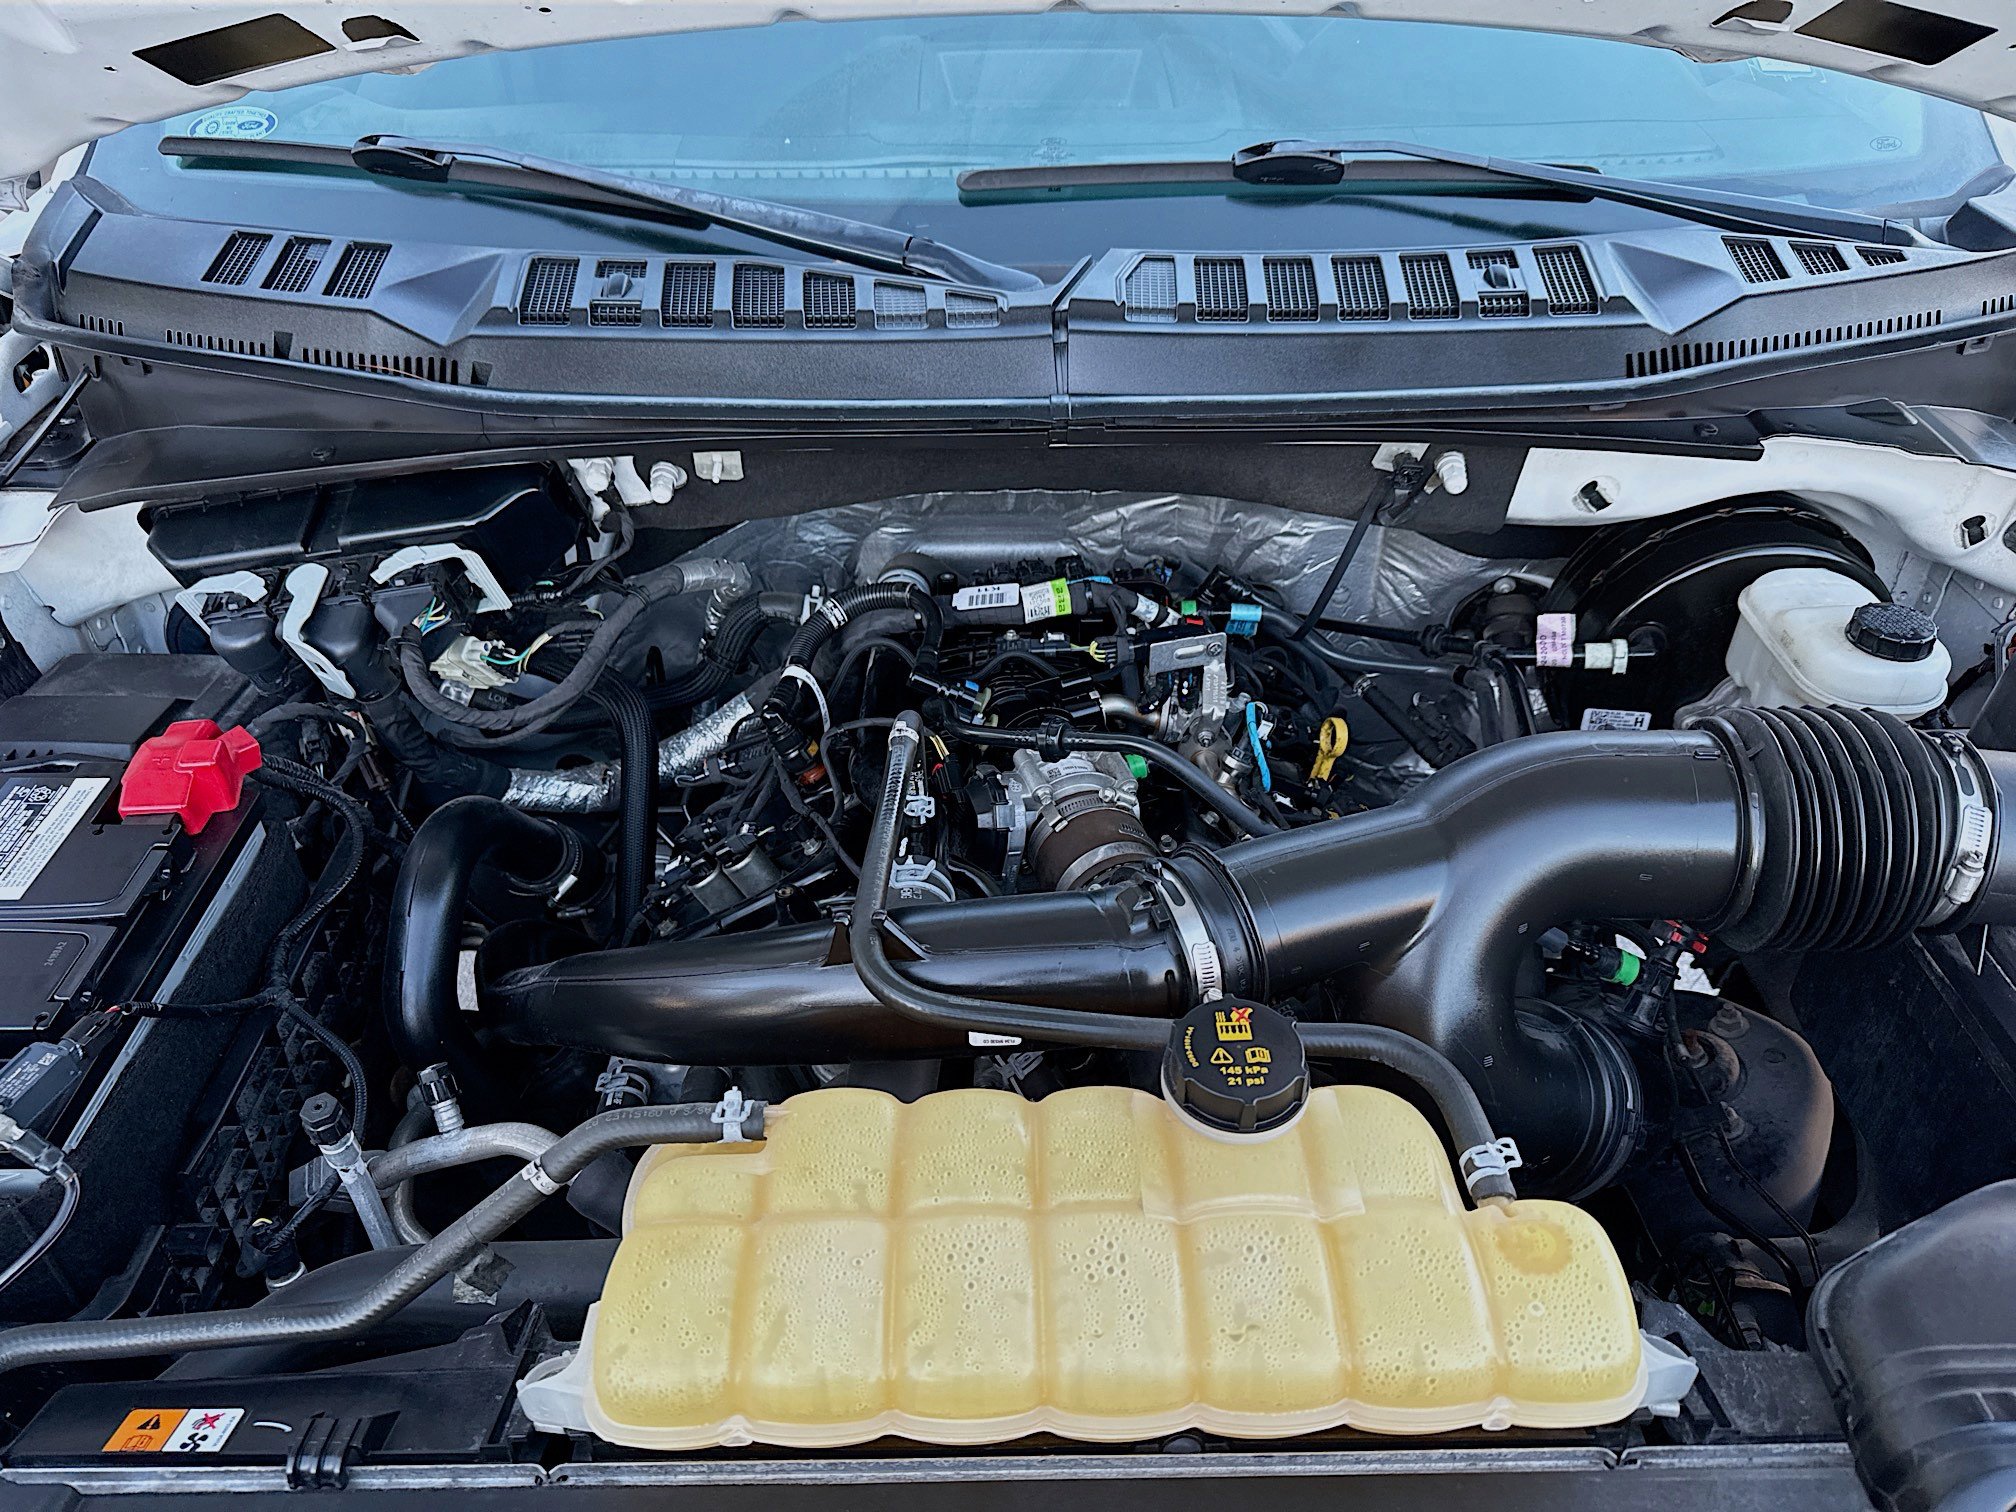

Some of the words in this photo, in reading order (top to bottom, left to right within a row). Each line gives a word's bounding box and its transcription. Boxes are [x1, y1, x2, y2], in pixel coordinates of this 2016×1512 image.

[1876, 138, 1898, 150] Ford
[1633, 716, 1645, 728] H
[1219, 1066, 1243, 1075] 145
[1245, 1066, 1269, 1075] kPa
[1227, 1076, 1242, 1086] 21
[1246, 1076, 1265, 1087] psi
